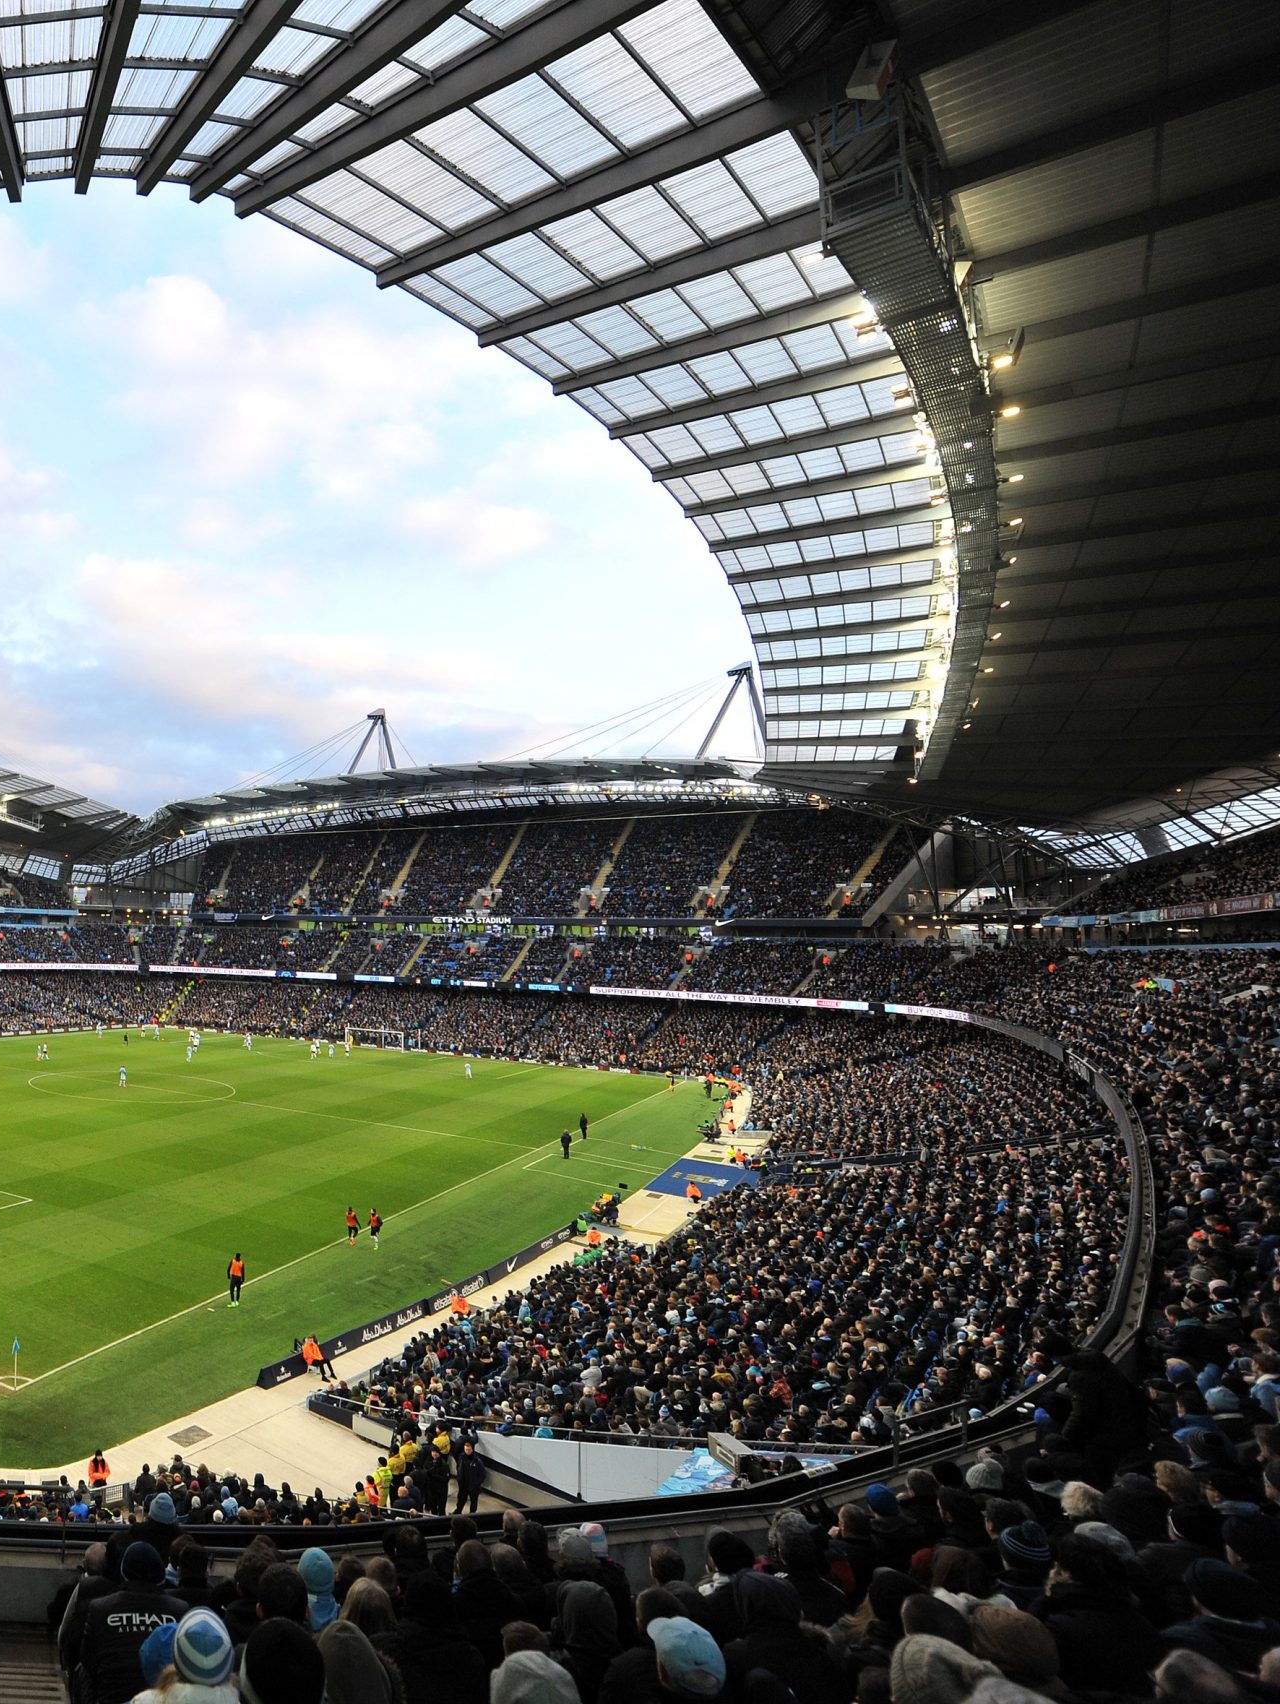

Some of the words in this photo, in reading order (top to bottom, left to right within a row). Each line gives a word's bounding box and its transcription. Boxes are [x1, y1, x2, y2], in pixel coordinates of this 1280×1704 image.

[432, 916, 475, 924] ETIHAD
[476, 916, 511, 924] STADIUM
[595, 988, 638, 996] SUPPORT
[748, 996, 801, 1005] WEMBLEY
[107, 1612, 177, 1626] ETIHAD
